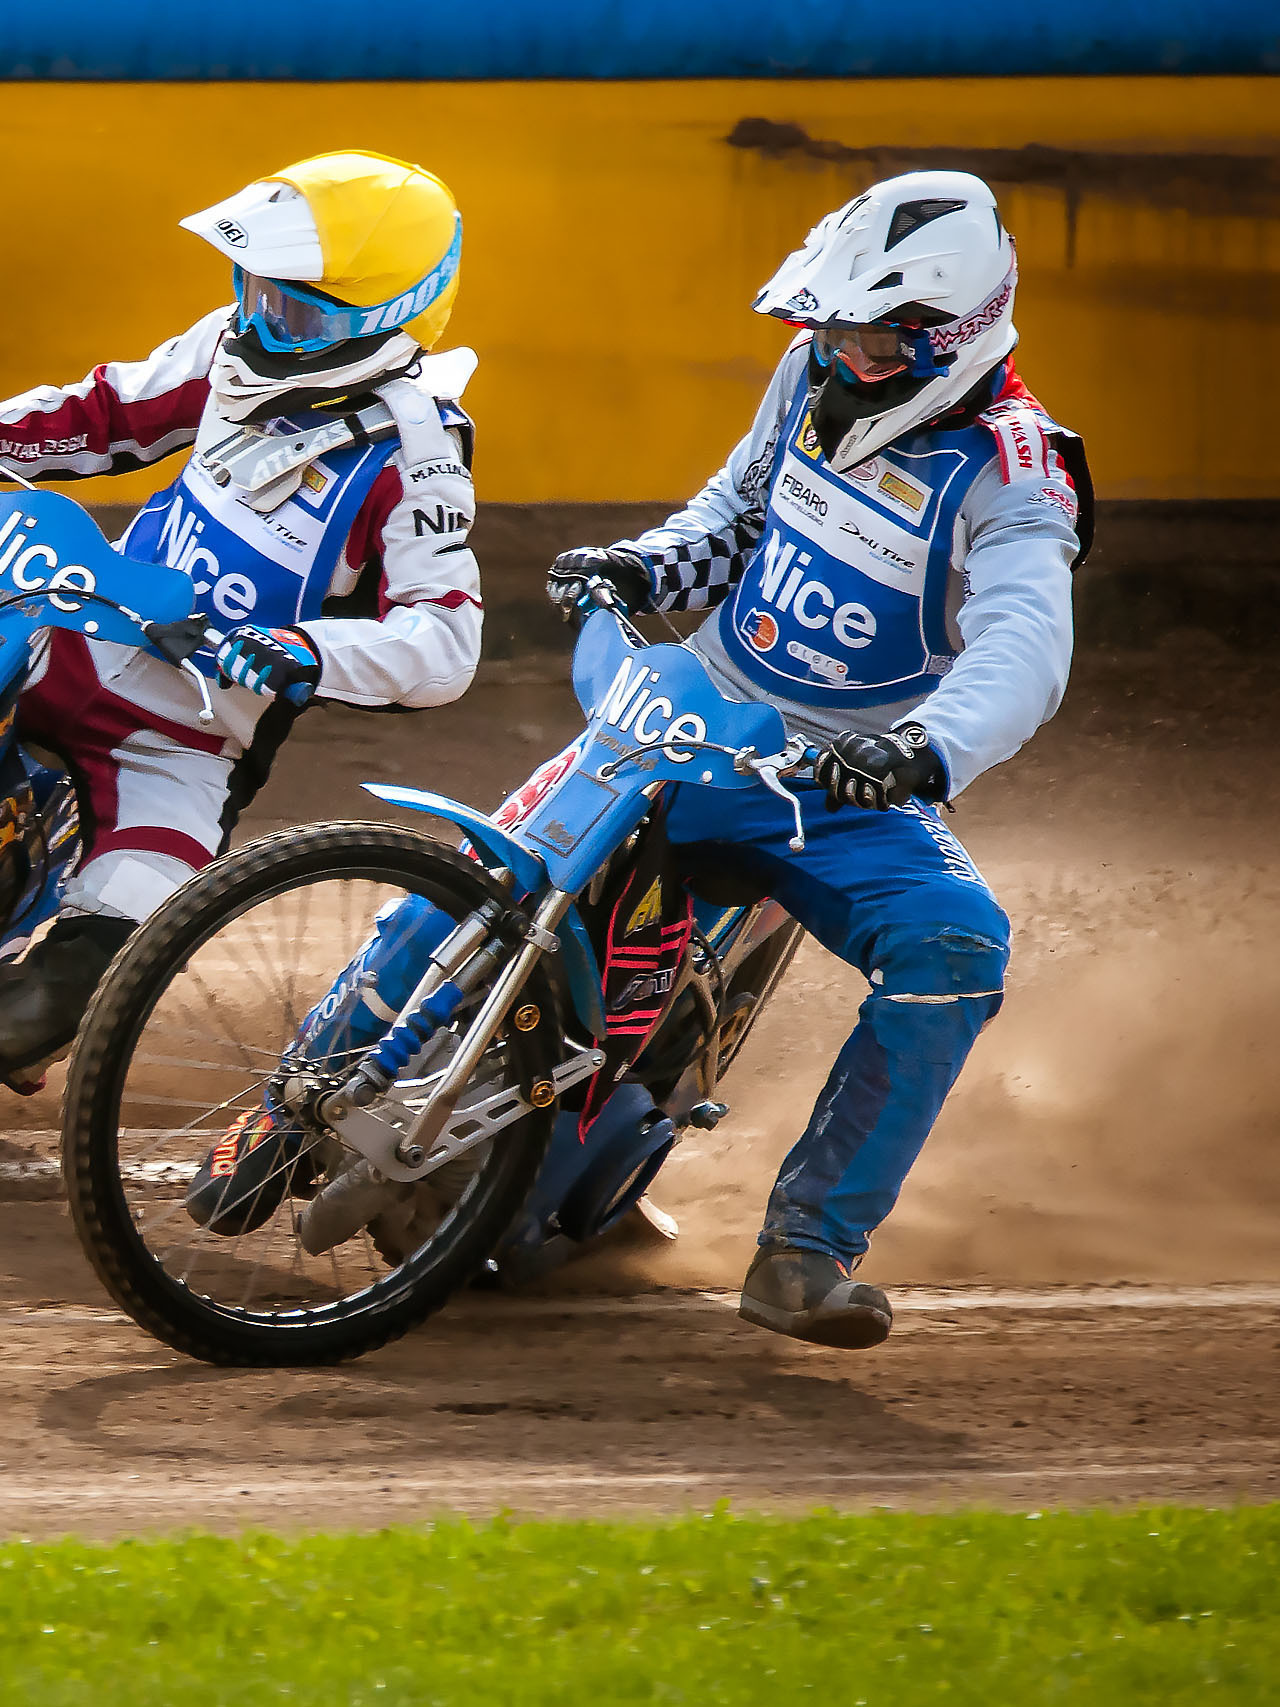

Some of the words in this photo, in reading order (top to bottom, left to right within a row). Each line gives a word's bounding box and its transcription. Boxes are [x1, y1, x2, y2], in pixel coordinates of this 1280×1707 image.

[781, 473, 829, 518] FIBARO
[156, 494, 258, 621] Nice
[759, 527, 877, 650] Nice
[594, 655, 707, 764] Nice
